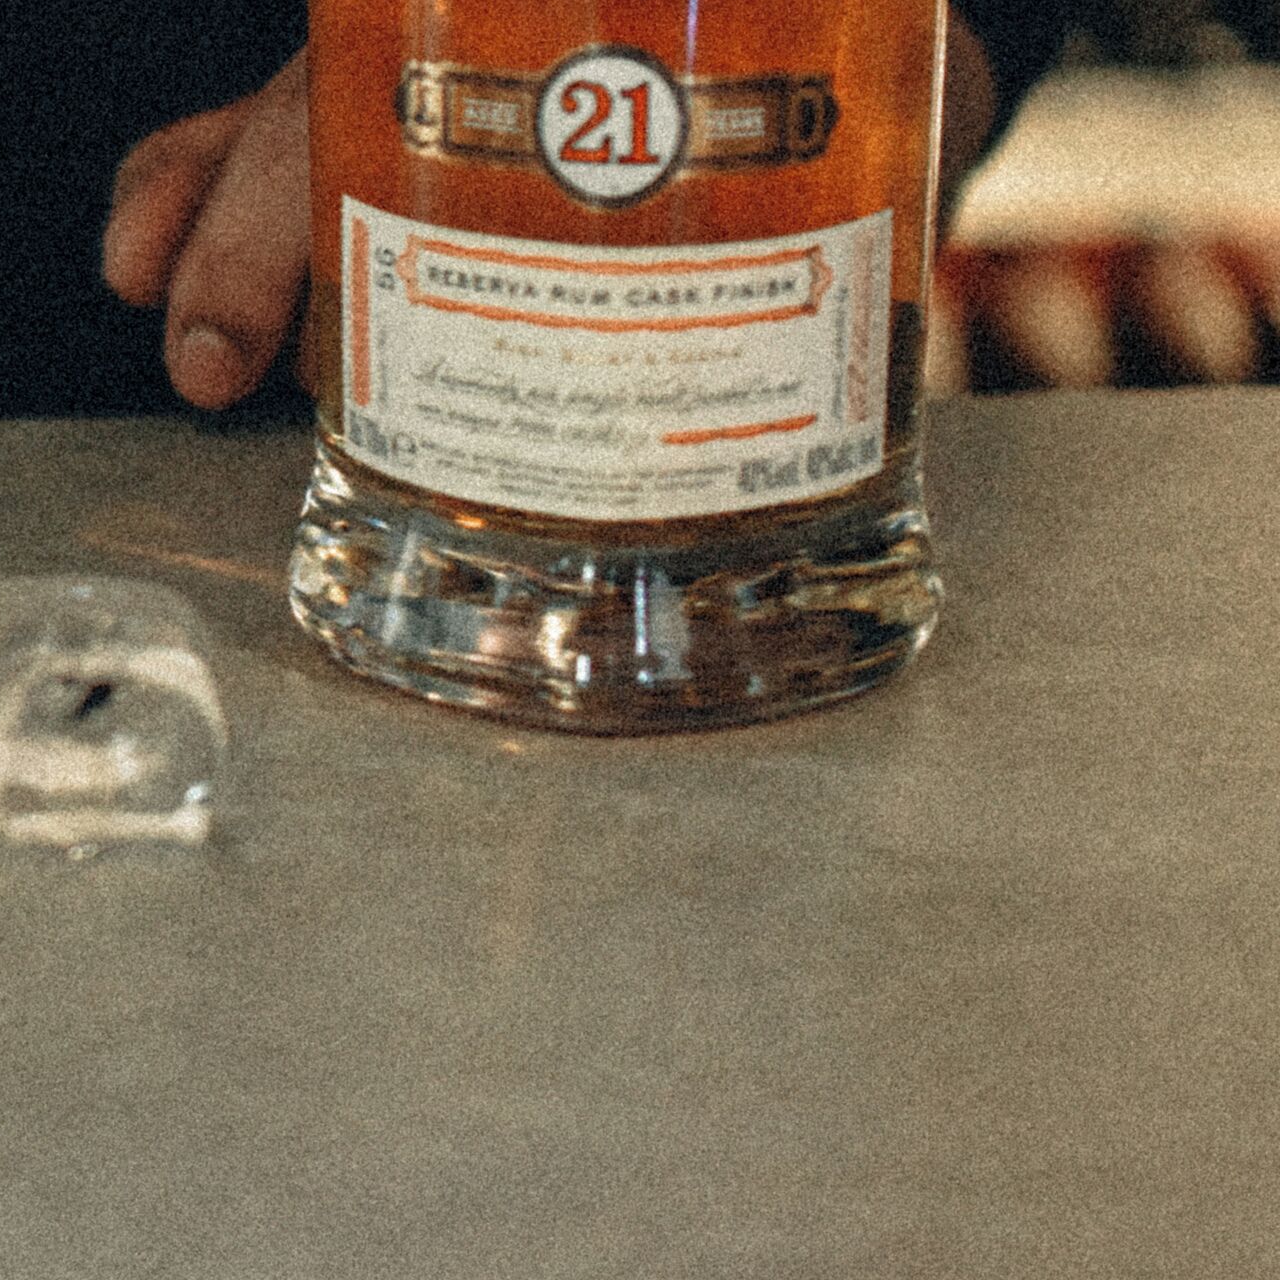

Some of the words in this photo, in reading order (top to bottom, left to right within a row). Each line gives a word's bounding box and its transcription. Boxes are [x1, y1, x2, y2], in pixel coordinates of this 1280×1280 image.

[559, 79, 659, 166] 21
[426, 265, 538, 300] RESERVA
[550, 283, 611, 307] RUM
[625, 284, 700, 309] CASK
[712, 276, 797, 302] FINISH
